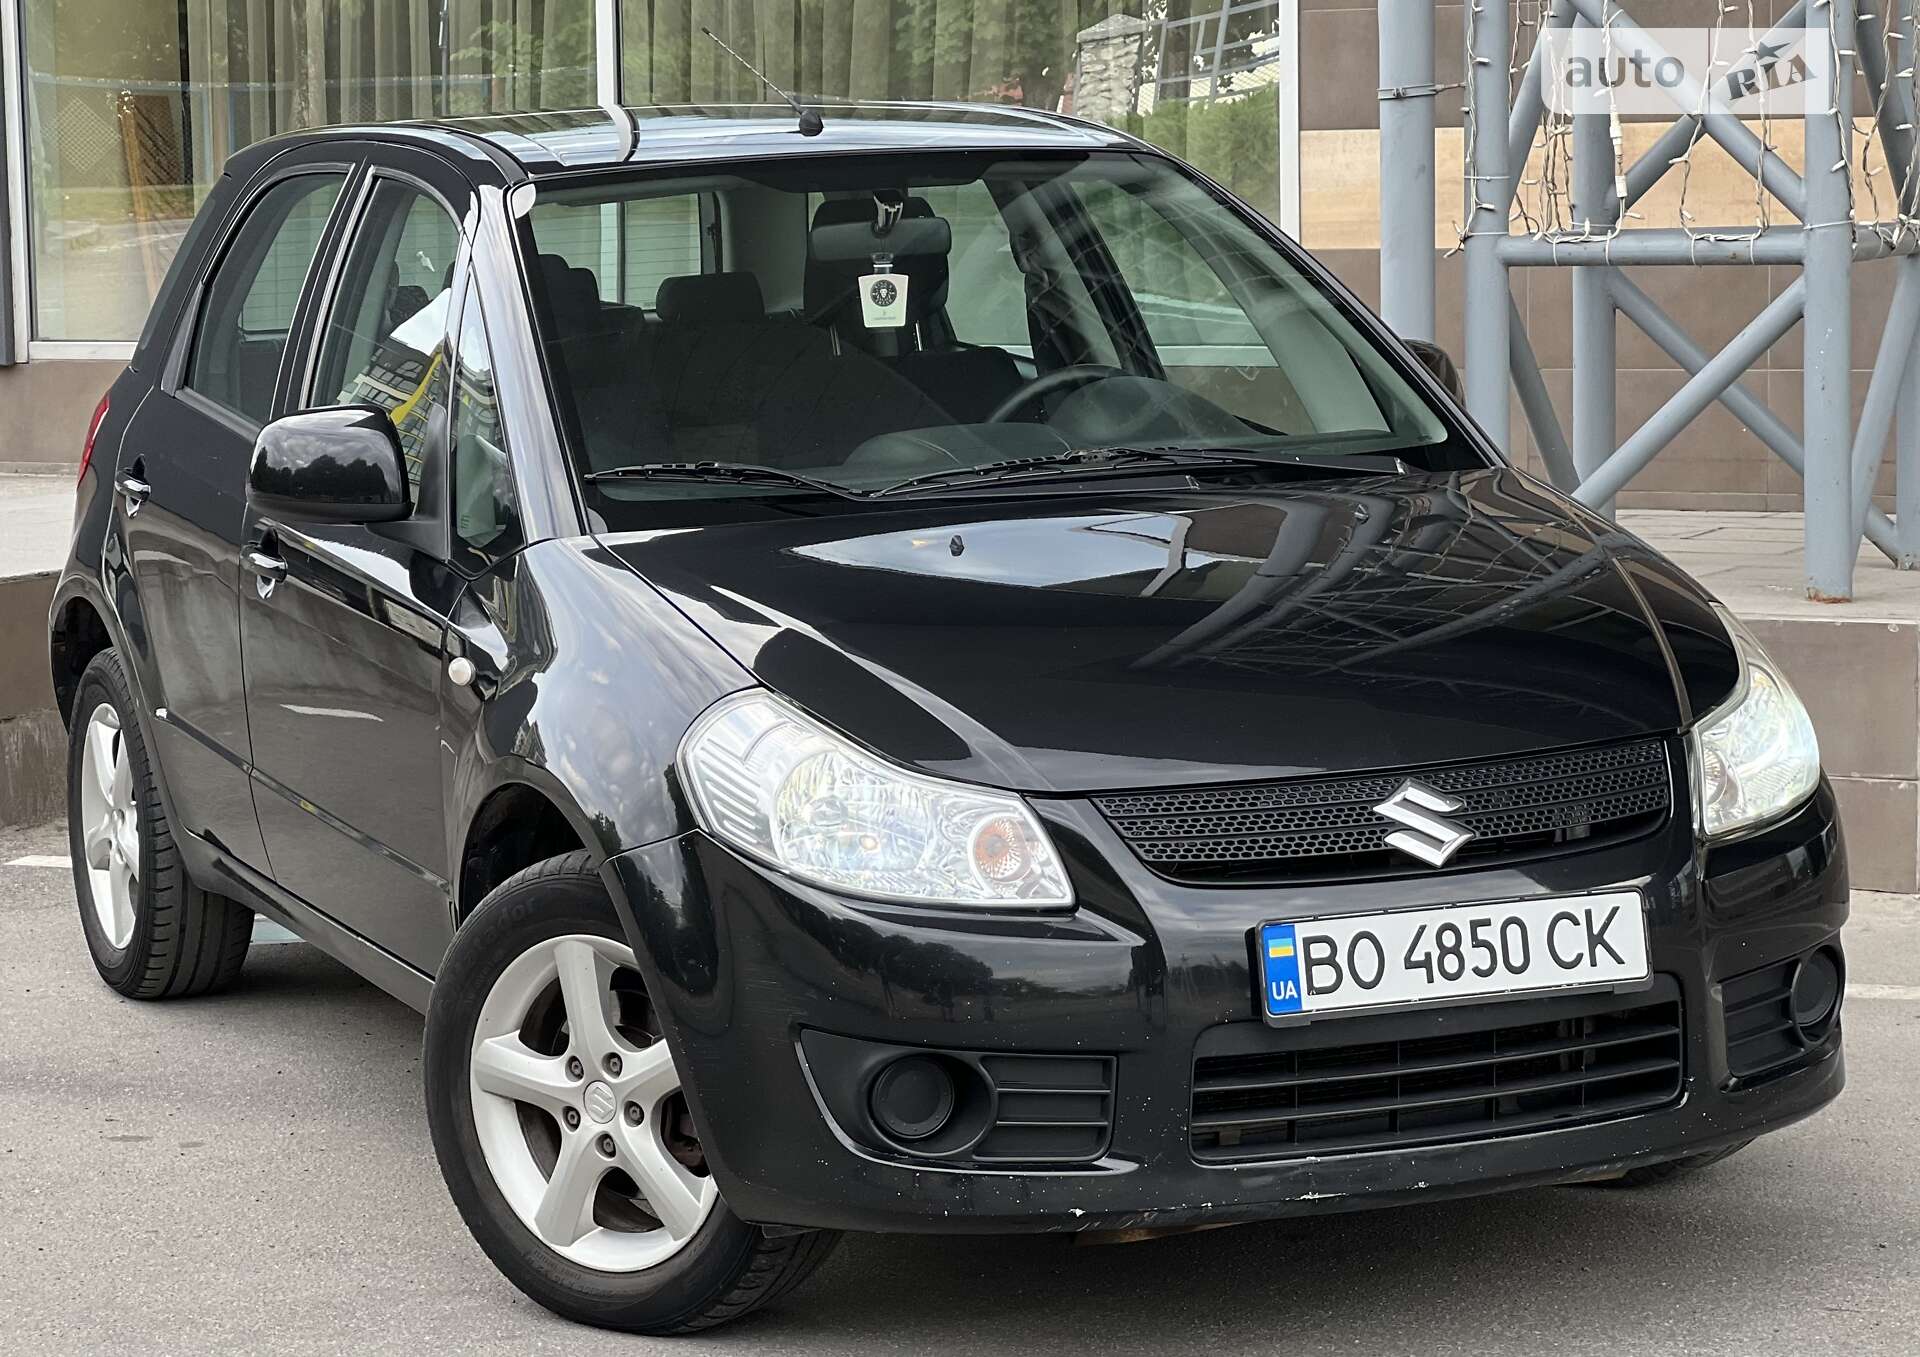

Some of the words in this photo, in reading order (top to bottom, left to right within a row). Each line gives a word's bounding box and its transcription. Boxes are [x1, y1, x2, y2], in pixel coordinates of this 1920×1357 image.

[1302, 930, 1386, 996] BO
[1403, 915, 1531, 984] 4850
[1547, 905, 1626, 970] CK
[1271, 980, 1298, 1001] UA
